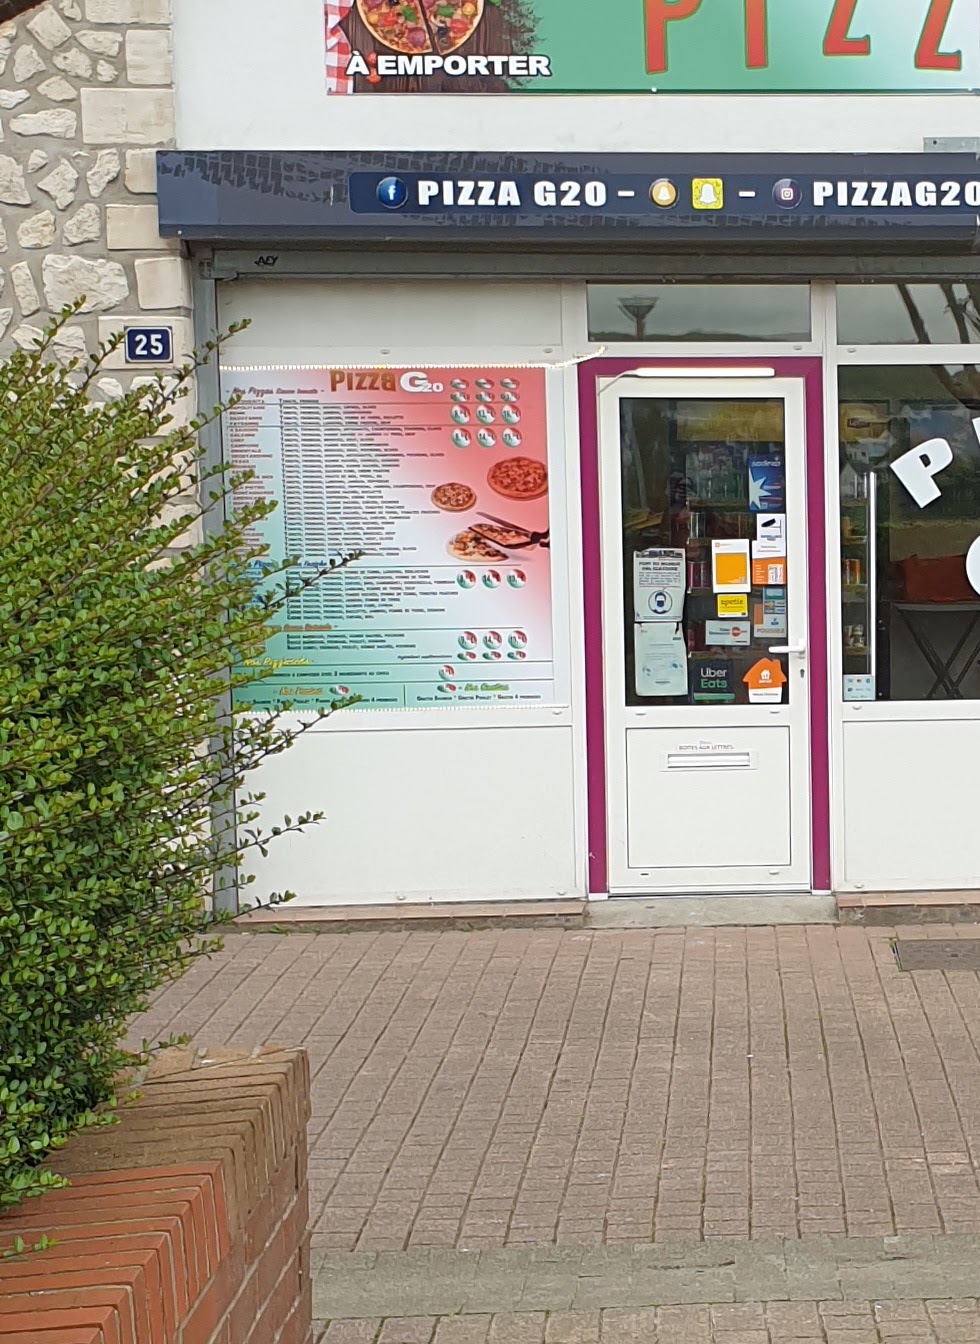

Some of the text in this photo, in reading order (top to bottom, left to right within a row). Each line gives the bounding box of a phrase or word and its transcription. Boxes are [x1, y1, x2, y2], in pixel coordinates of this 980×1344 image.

[346, 50, 551, 76] À EMPORTER
[418, 180, 521, 207] PIZZA
[534, 181, 607, 207] G20
[134, 333, 164, 356] 25
[700, 667, 728, 678] Uber
[701, 679, 728, 689] Eats
